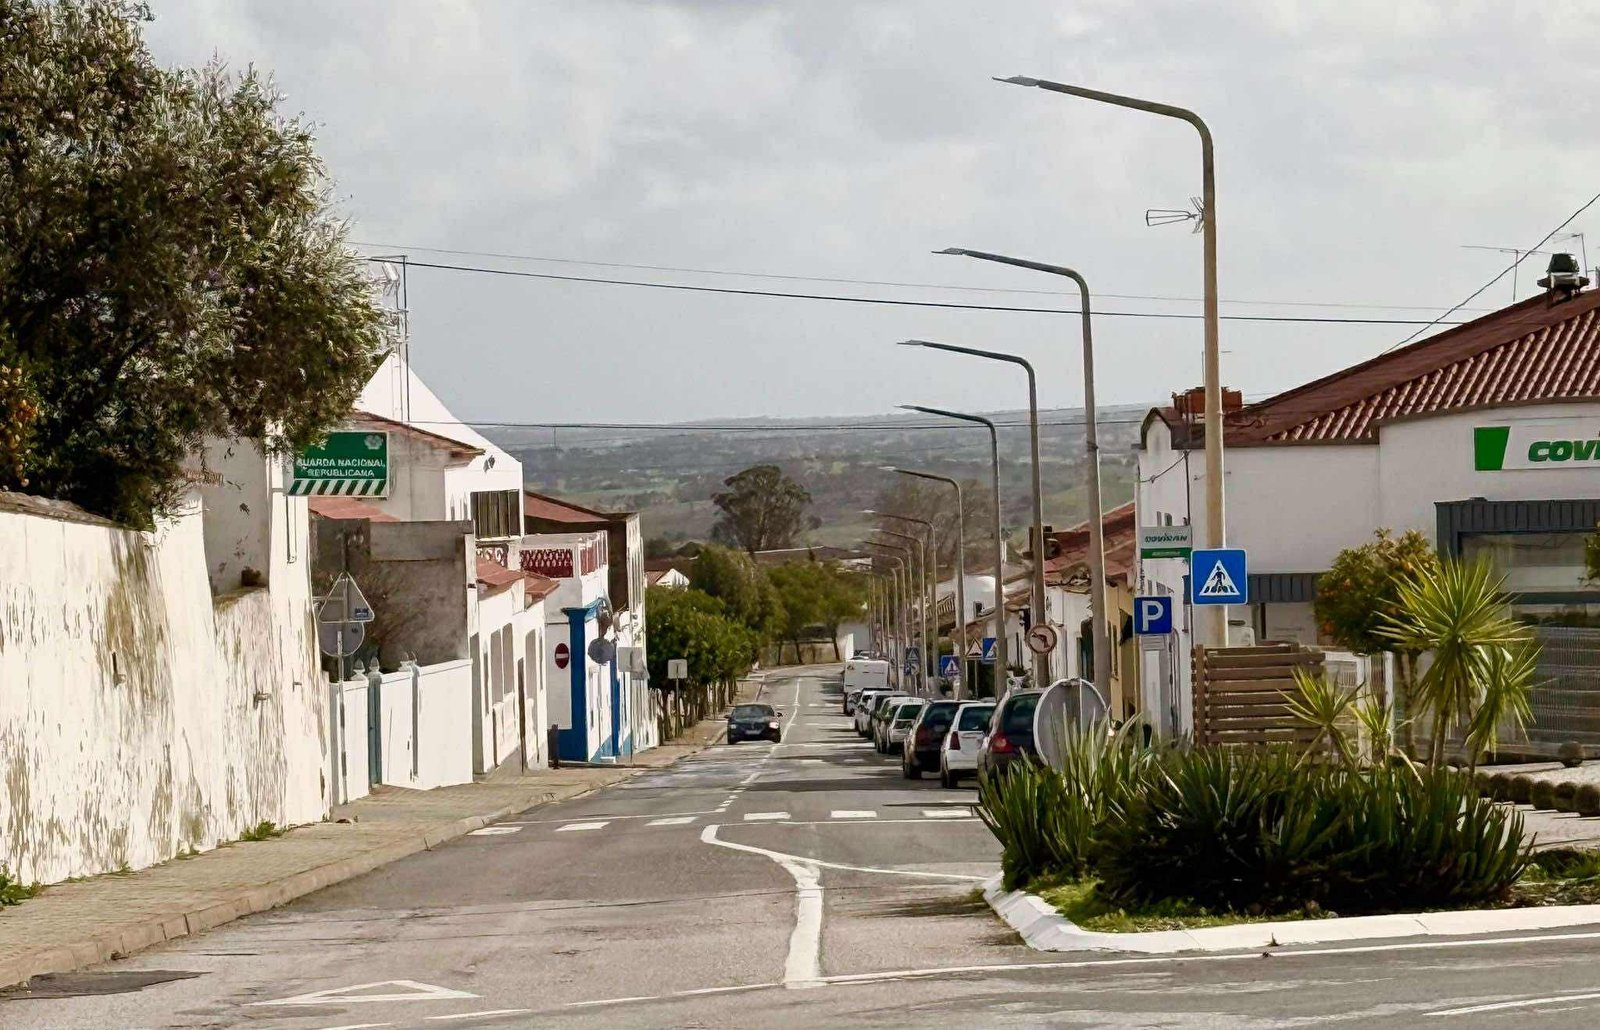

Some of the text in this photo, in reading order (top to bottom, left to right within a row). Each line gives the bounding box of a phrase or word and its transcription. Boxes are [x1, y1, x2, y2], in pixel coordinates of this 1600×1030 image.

[338, 458, 385, 467] NACIONAL
[307, 468, 375, 477] REPUBLICANA
[1142, 600, 1164, 631] P
